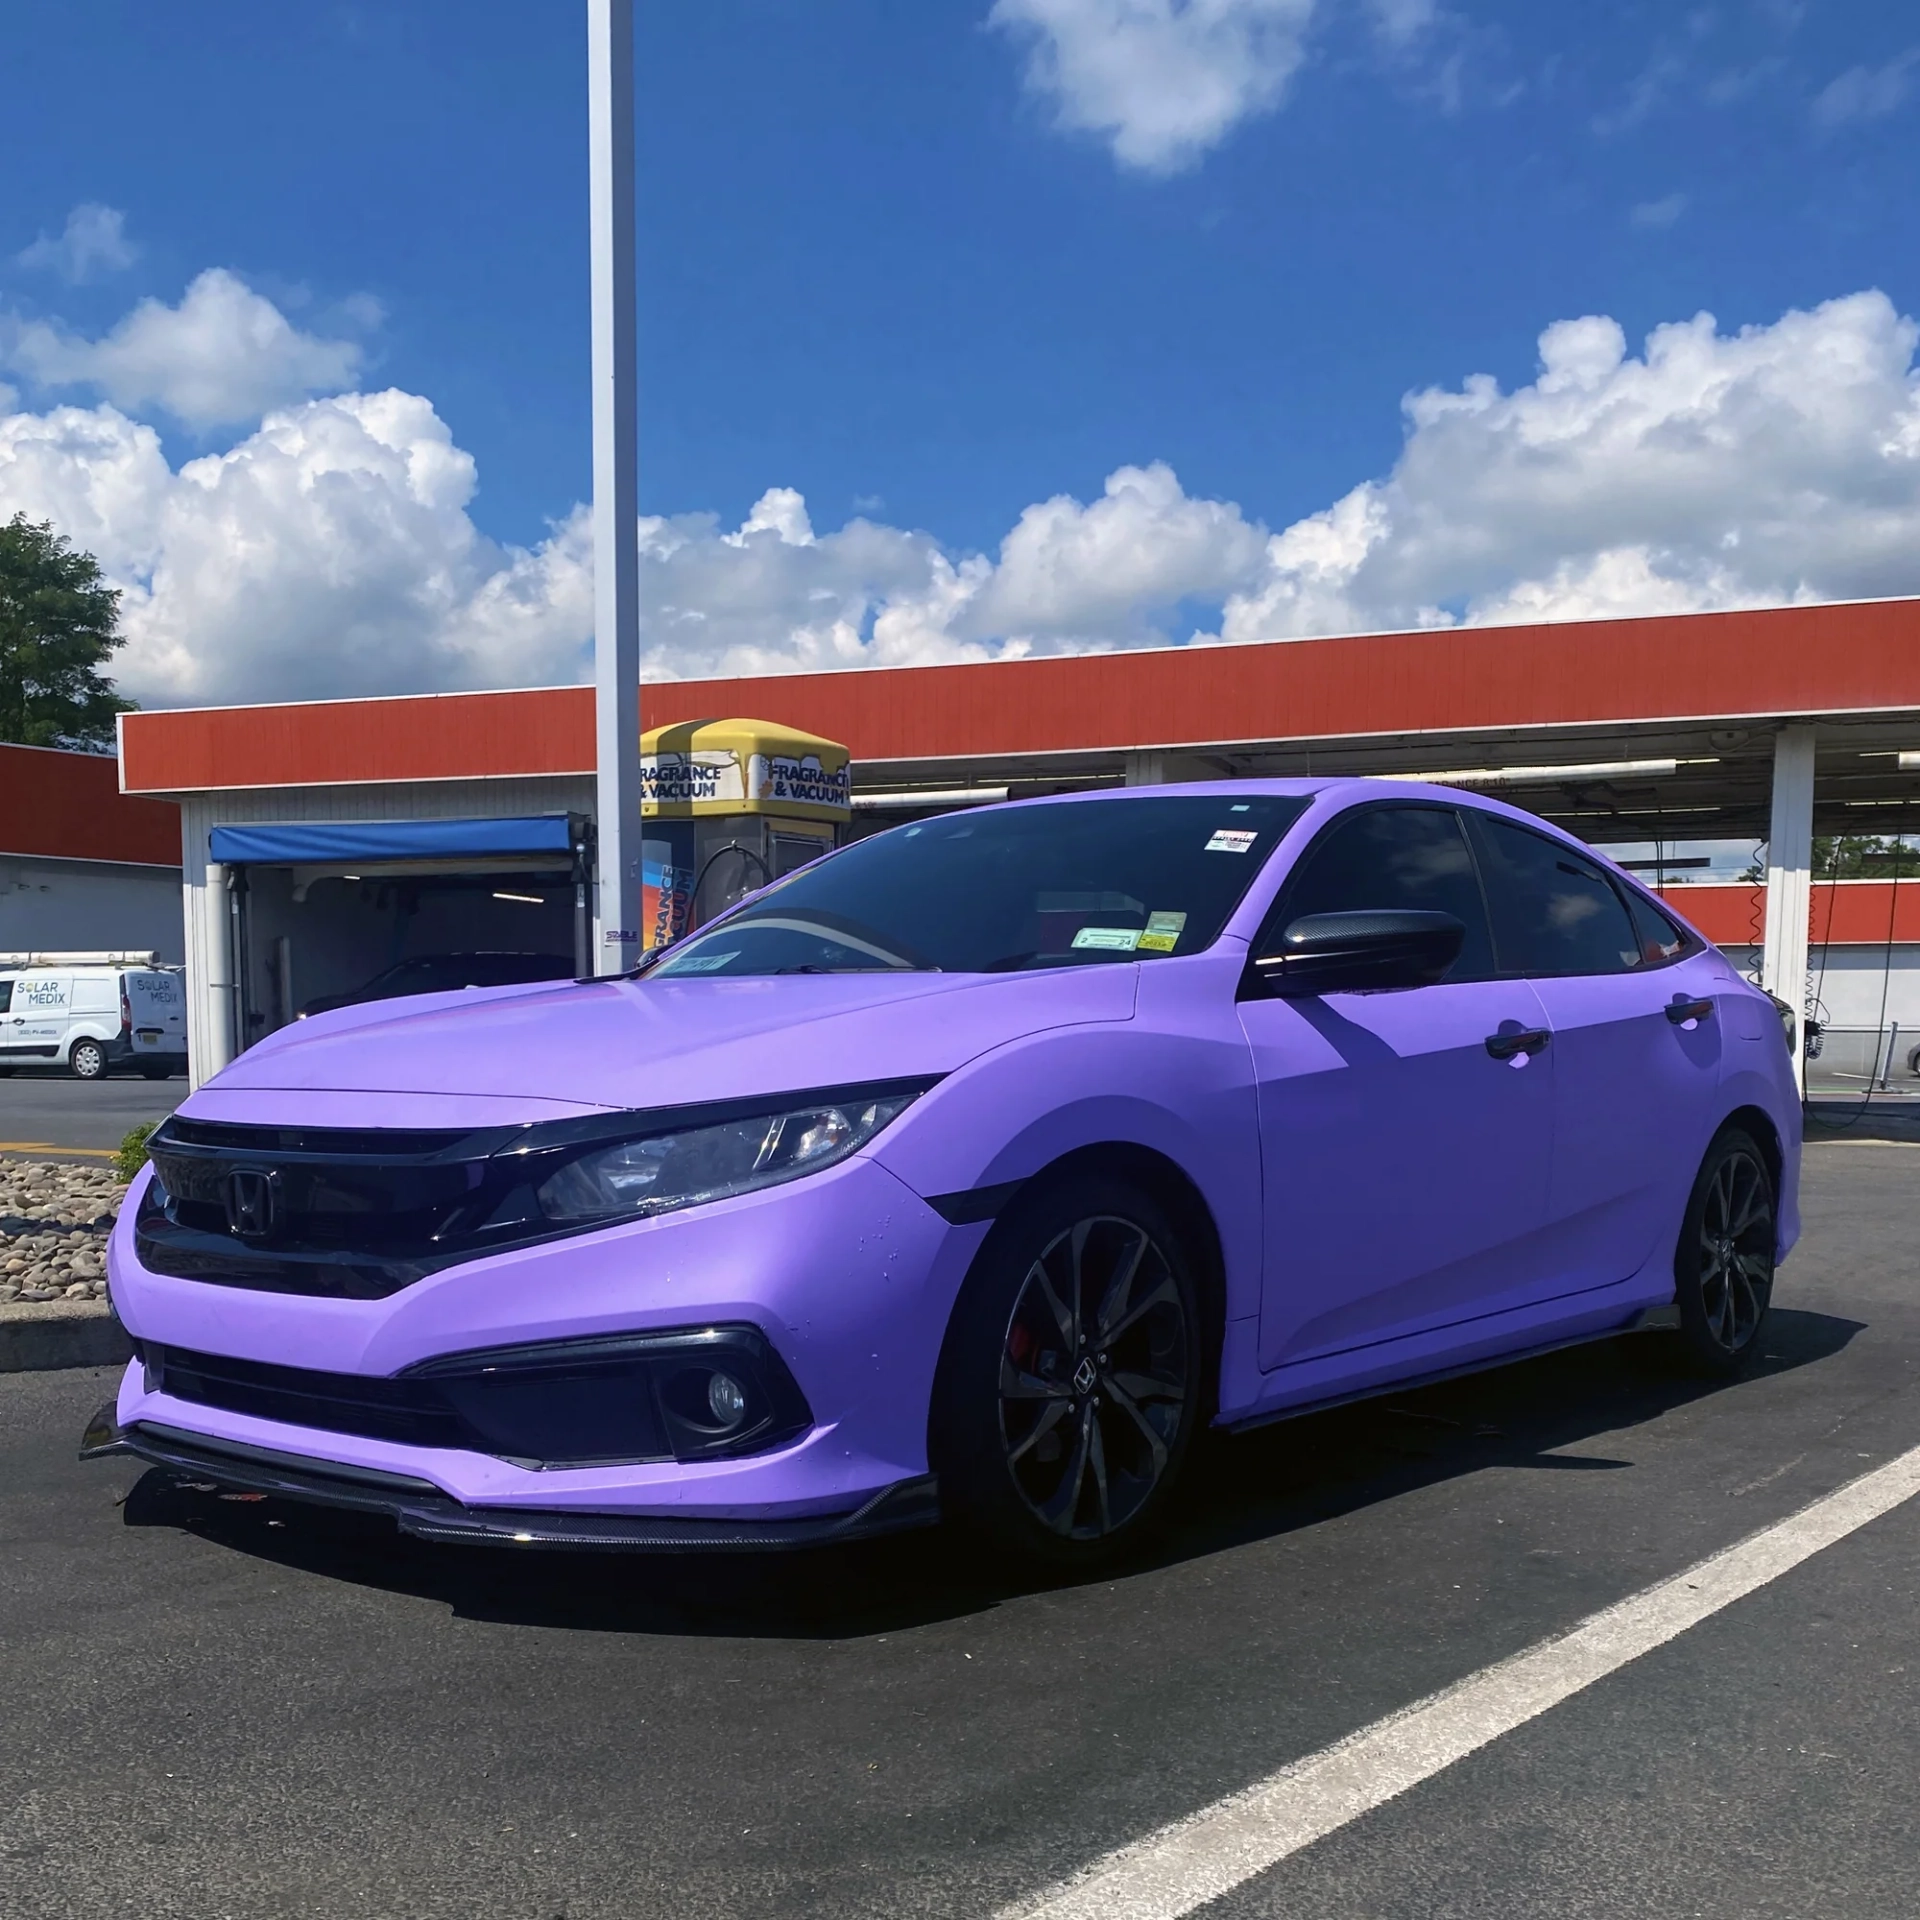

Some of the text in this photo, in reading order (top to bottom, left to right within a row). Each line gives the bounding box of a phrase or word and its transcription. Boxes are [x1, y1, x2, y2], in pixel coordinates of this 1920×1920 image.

[640, 766, 721, 781] RAGRANCE
[648, 782, 716, 798] VACUUM
[775, 780, 844, 804] & VACUUM
[17, 982, 58, 994] SOLAR
[137, 979, 170, 991] SOLAR
[29, 993, 65, 1004] MEDIX
